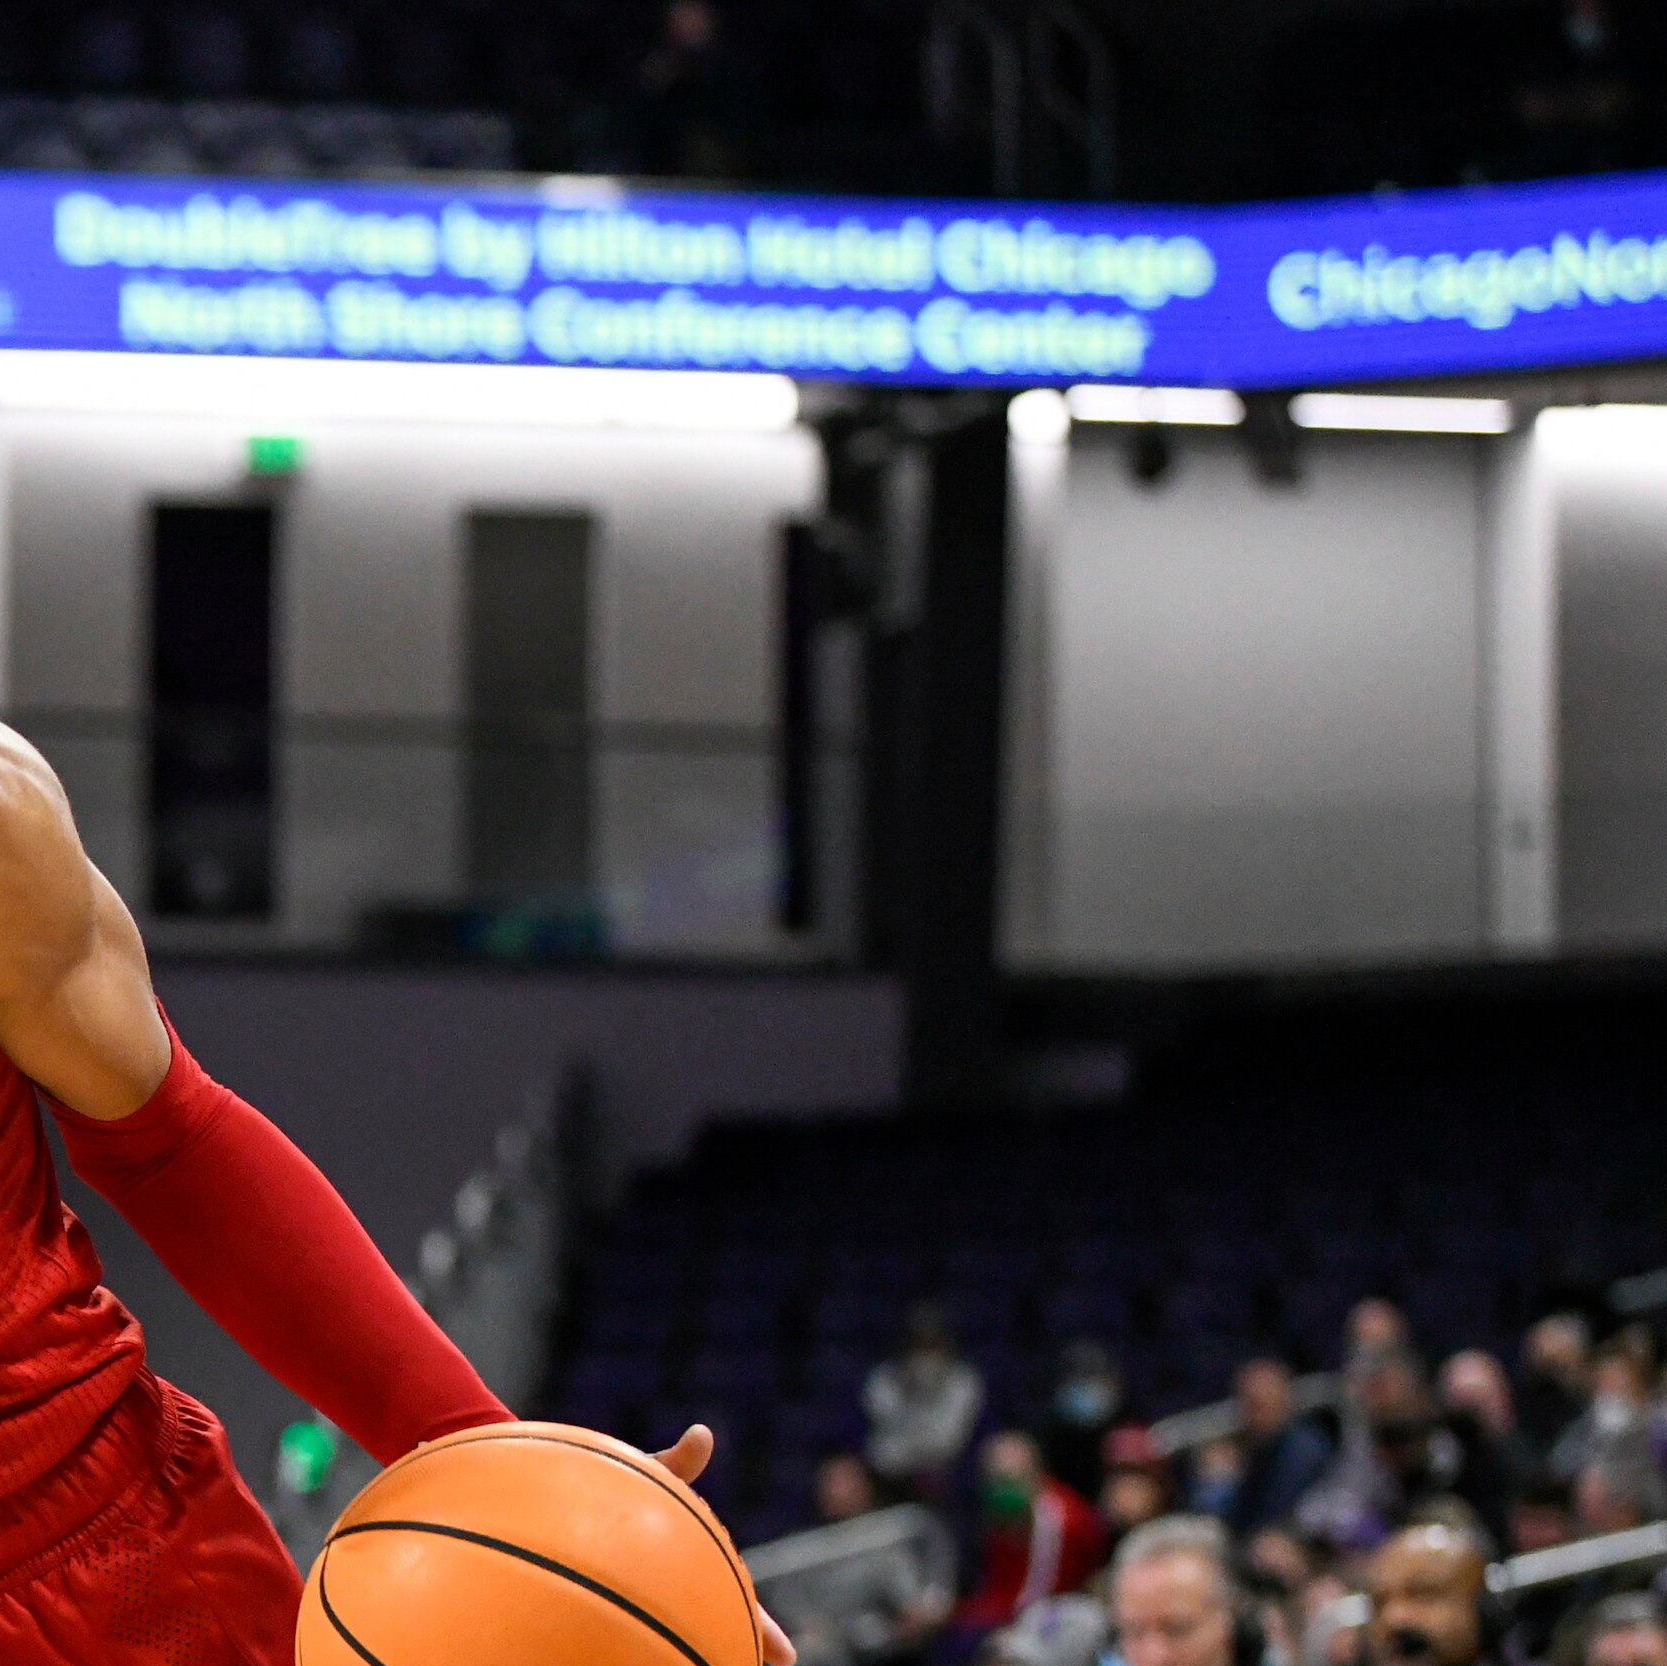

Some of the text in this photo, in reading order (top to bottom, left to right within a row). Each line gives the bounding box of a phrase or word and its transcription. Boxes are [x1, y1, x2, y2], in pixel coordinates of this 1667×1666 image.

[53, 192, 437, 278] DoubleTree
[441, 201, 533, 291] by
[934, 217, 1217, 311] Chicago
